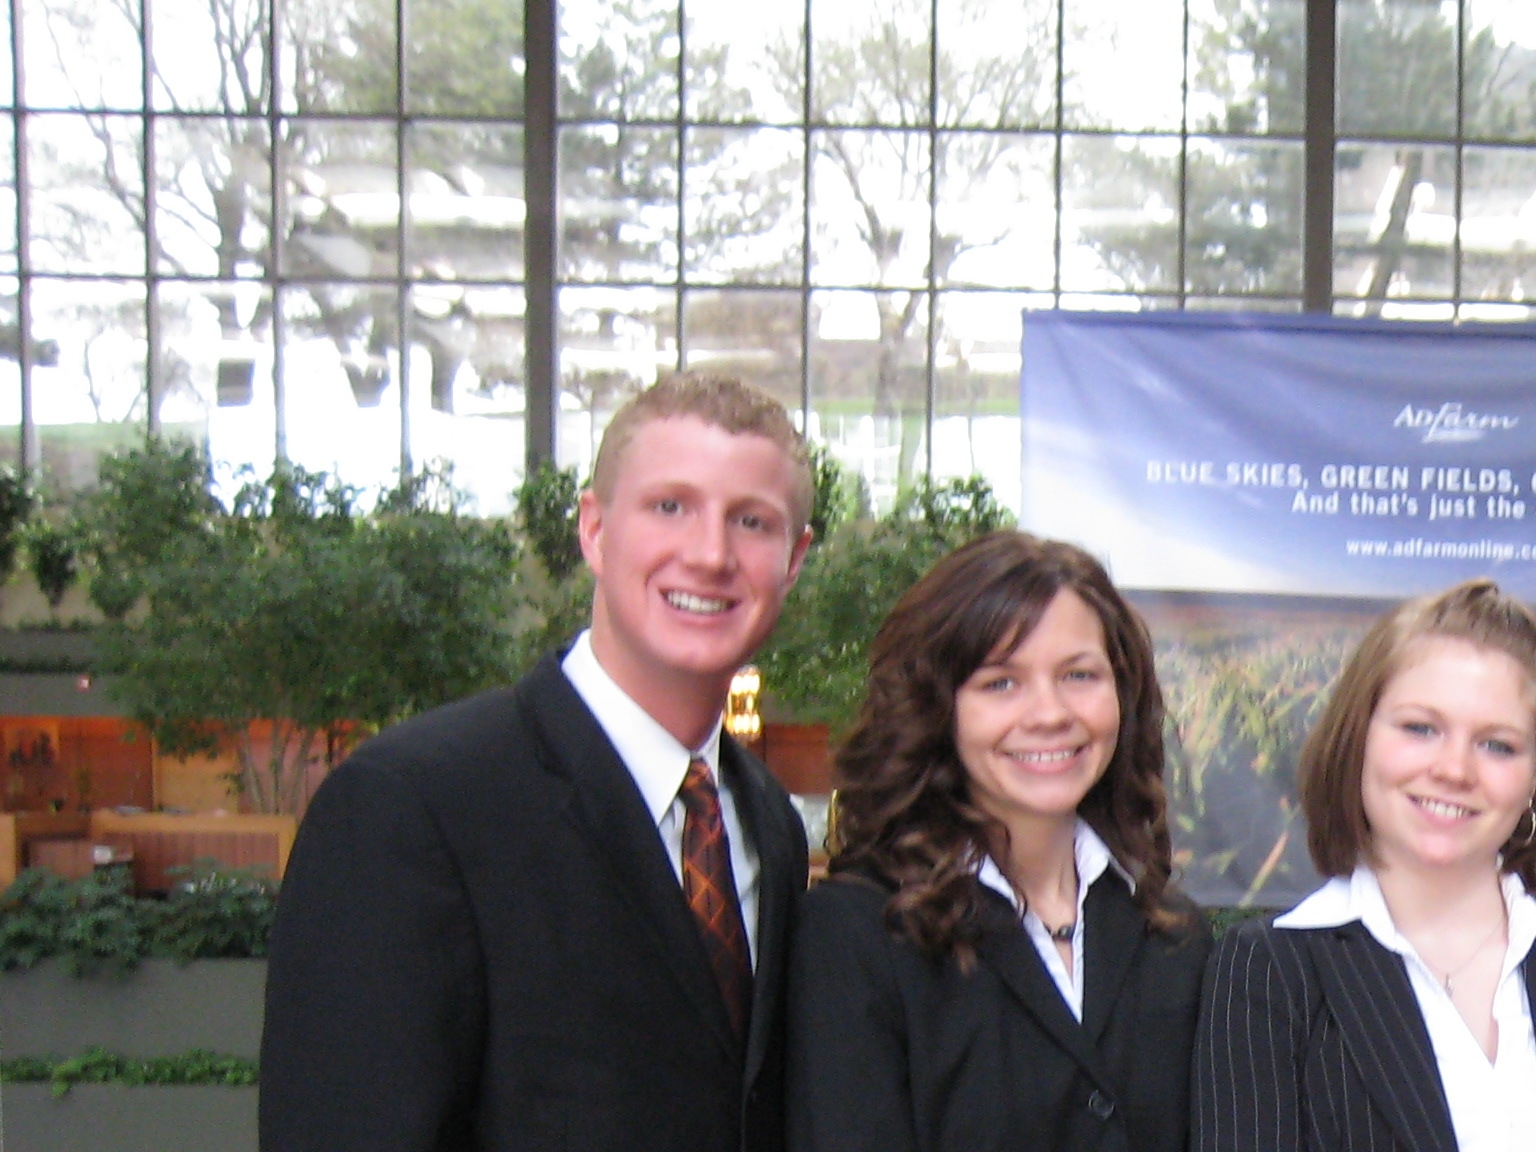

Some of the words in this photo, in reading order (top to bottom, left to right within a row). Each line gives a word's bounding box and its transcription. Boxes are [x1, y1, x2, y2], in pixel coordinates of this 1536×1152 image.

[1146, 460, 1214, 485] BLUE
[1226, 462, 1309, 490] SKIES,
[1321, 464, 1410, 490] GREEN
[1421, 467, 1520, 496] FIELDS,
[1291, 490, 1340, 514] And
[1350, 492, 1419, 516] that's
[1429, 493, 1477, 521] just
[1487, 495, 1527, 519] the
